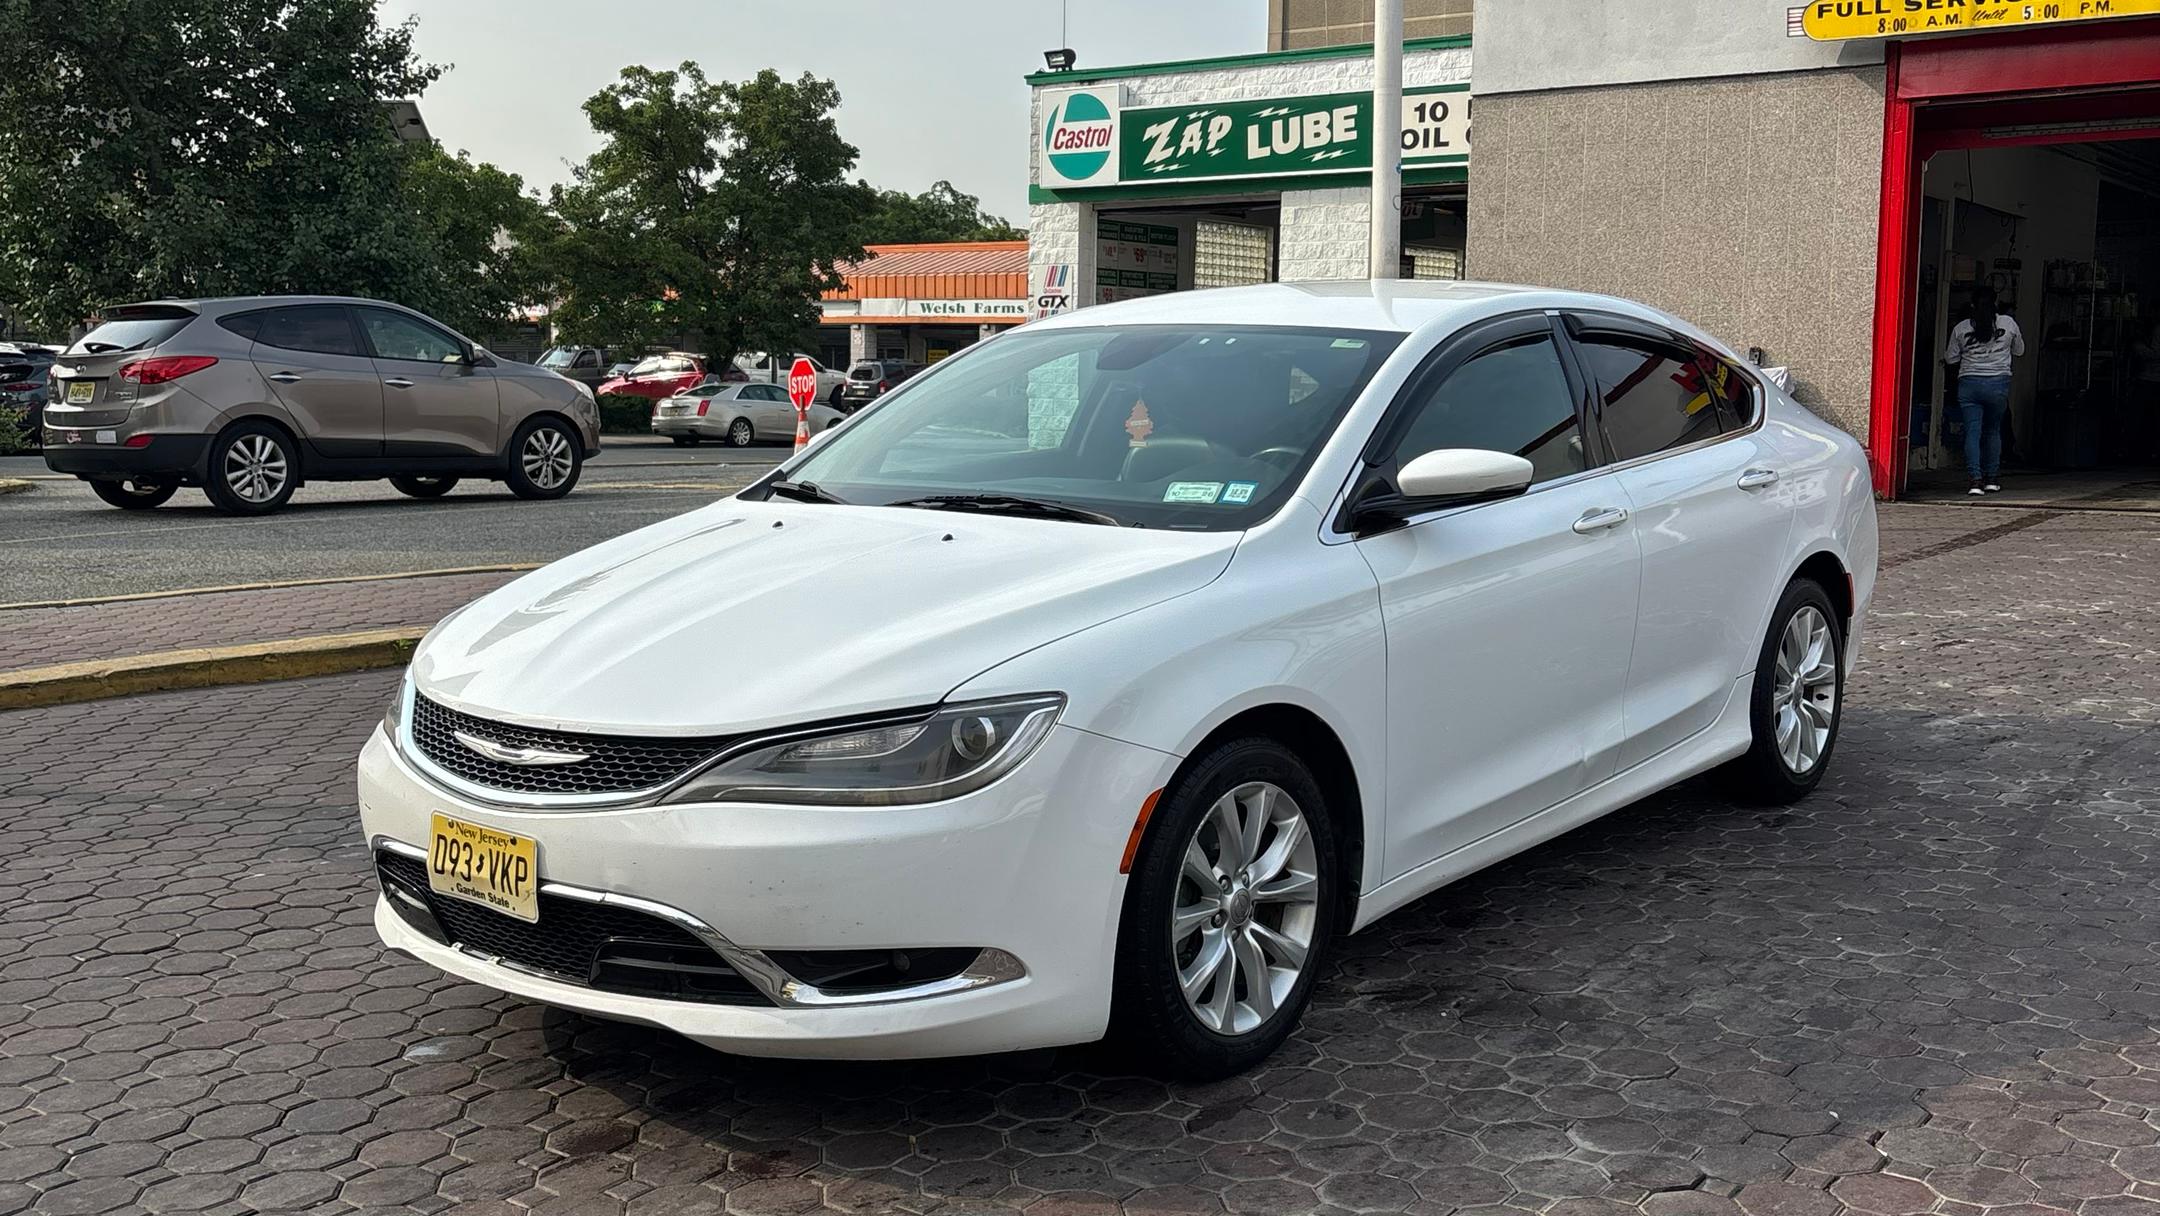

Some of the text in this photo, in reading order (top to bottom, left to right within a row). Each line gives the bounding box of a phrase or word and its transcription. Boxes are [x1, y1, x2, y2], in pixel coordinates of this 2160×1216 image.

[1818, 0, 1891, 19] FULL
[1878, 18, 1907, 33] 8:00
[1927, 13, 1963, 27] A.M.
[2023, 4, 2059, 20] 5:00
[2080, 0, 2115, 14] P.M.
[1414, 101, 1449, 123] 10
[1053, 124, 1113, 150] Castrol
[1142, 104, 1358, 166] ZAP LUBE
[1401, 127, 1449, 150] OIL
[920, 302, 1025, 314] Welsh Farms
[1038, 295, 1070, 309] GTX
[791, 374, 815, 395] STOP
[455, 822, 510, 850] New Jersey
[434, 833, 528, 898] D93 VKP
[456, 882, 510, 908] Garden State
